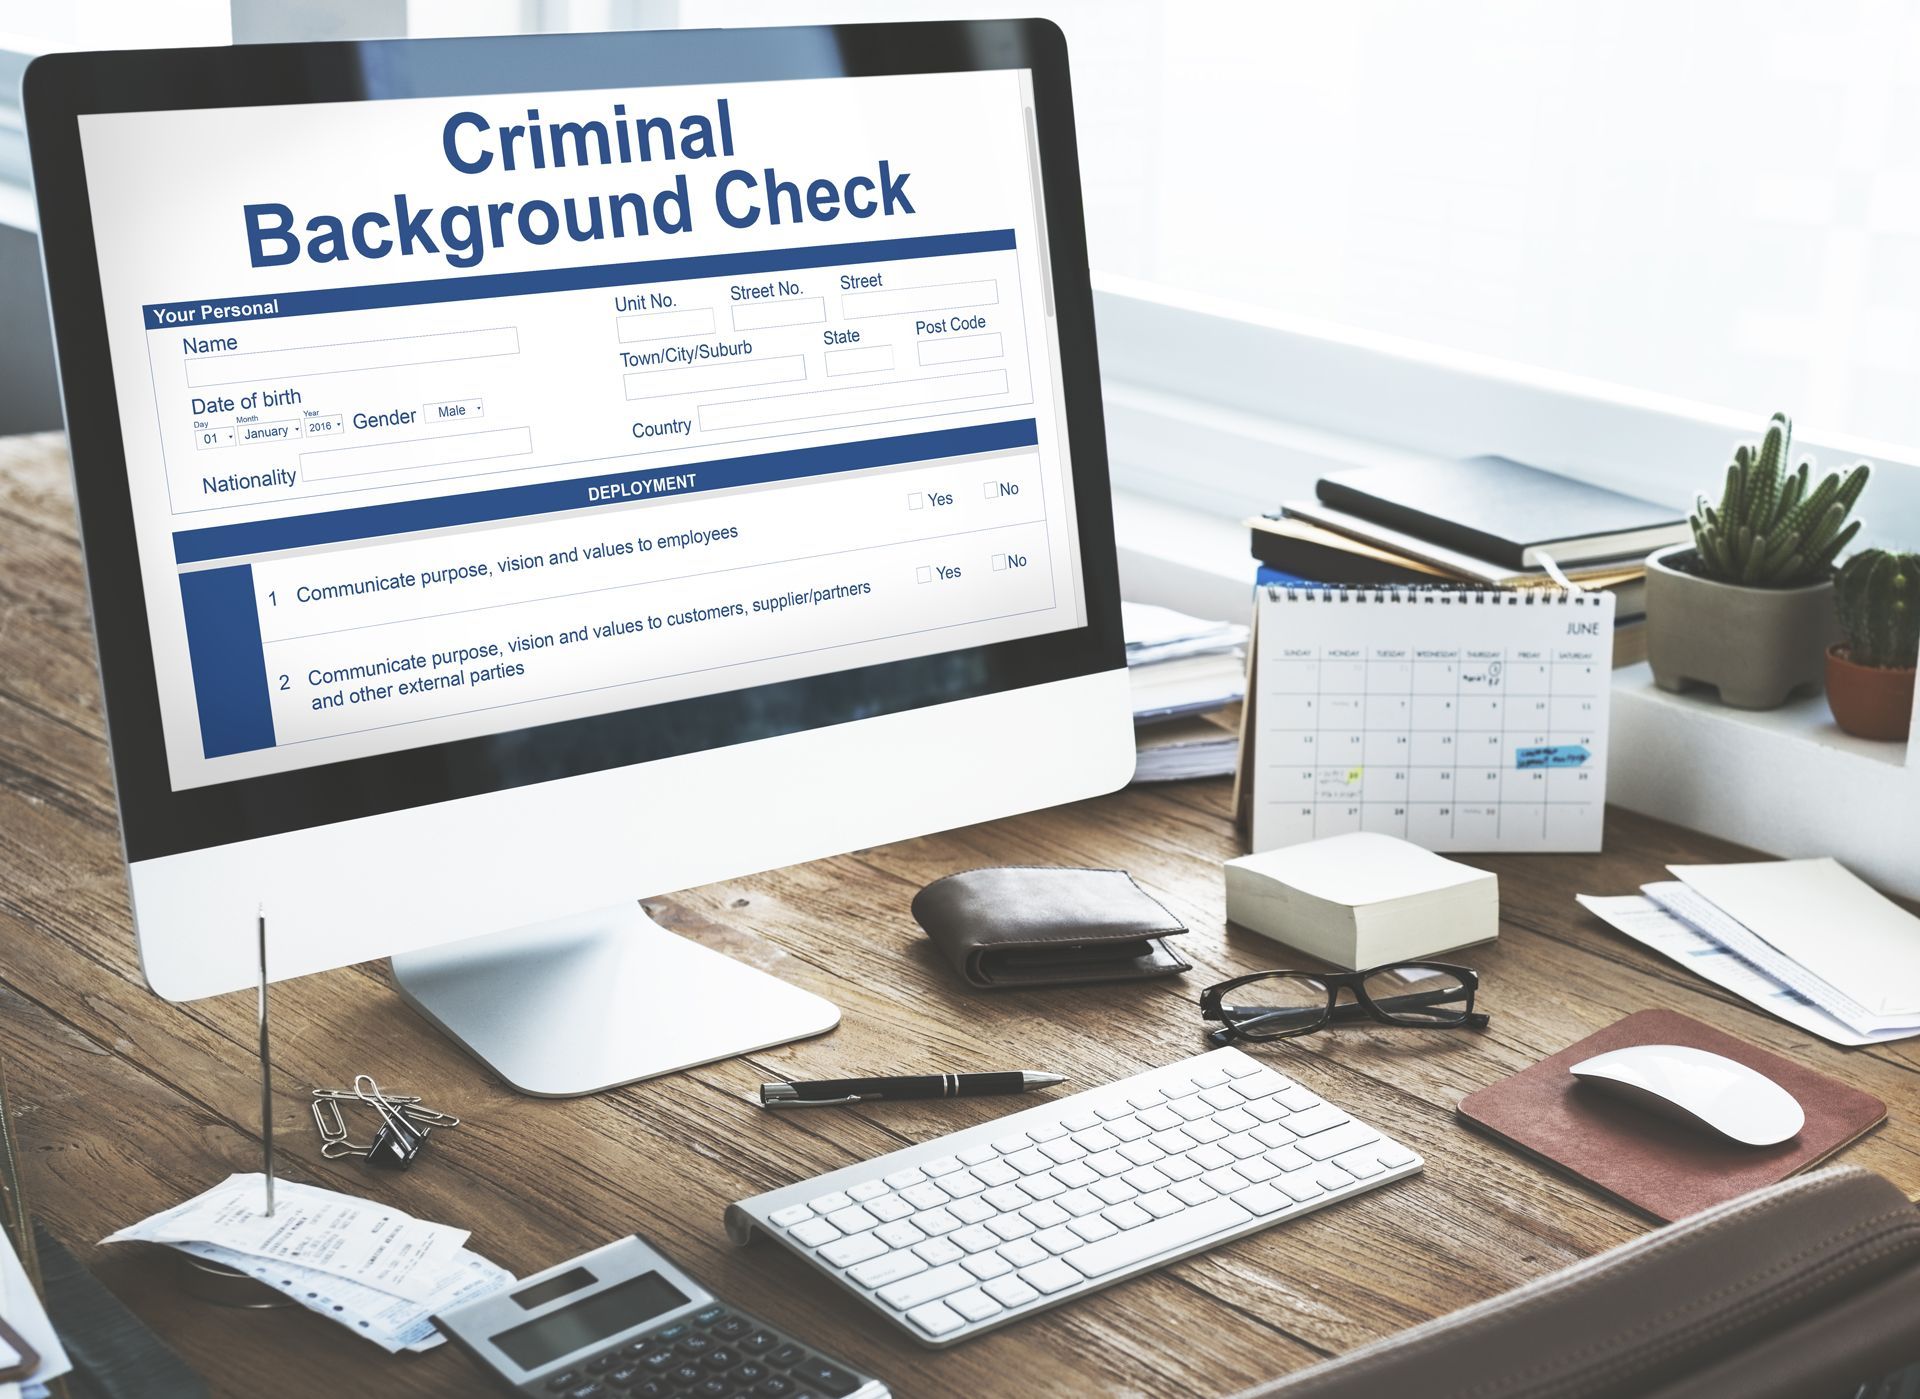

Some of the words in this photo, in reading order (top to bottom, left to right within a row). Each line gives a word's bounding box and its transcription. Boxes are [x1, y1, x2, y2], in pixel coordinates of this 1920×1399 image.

[442, 98, 735, 175] Criminal
[243, 173, 693, 269] Background
[715, 159, 917, 229] Check
[730, 282, 776, 301] Street
[778, 280, 804, 297] No.
[840, 272, 883, 290] Street
[152, 308, 196, 324] Your
[200, 298, 279, 320] Personal
[614, 294, 647, 313] Unit
[650, 292, 677, 309] No.
[915, 319, 948, 336] Post
[950, 314, 986, 332] Code
[182, 337, 238, 355] Name
[823, 328, 861, 346] State
[619, 339, 753, 368] Town/City/Suburb
[191, 396, 235, 416] Date
[240, 391, 258, 410] of
[262, 388, 302, 408] birth
[438, 404, 466, 418] Male
[236, 415, 259, 424] Month
[303, 409, 320, 418] Year
[352, 408, 417, 430] Gender
[193, 421, 209, 430] Day
[244, 425, 289, 440] January
[309, 421, 332, 433] 2016
[632, 418, 692, 439] Country
[203, 432, 217, 445] 01
[202, 468, 297, 495] Nationality
[587, 473, 697, 502] DEPLOYMENT
[927, 492, 954, 507] Yes
[999, 481, 1019, 497] No
[268, 590, 277, 607] 1
[296, 571, 416, 603] Communicate
[421, 563, 493, 586] purpose,
[497, 553, 544, 573] vision
[549, 546, 578, 566] and
[583, 540, 634, 561] values
[637, 537, 653, 553] to
[657, 525, 739, 551] employees
[936, 565, 962, 580] Yes
[1007, 553, 1027, 569] No
[278, 674, 291, 691] 2
[308, 653, 427, 686] Communicate
[431, 641, 504, 669] purpose,
[508, 633, 554, 654] vision
[559, 625, 589, 645] and
[593, 619, 643, 640] values
[648, 614, 662, 630] to
[667, 602, 749, 627] customers,
[752, 580, 871, 613] supplier/partners
[1566, 622, 1599, 636] JUNE
[1283, 649, 1312, 657] SUNDAY
[1328, 649, 1360, 658] MONDAY
[1376, 650, 1406, 658] TUESDAY
[1416, 650, 1457, 658] WEDNESDAY
[1517, 651, 1541, 659] FRIDAY
[1559, 652, 1593, 660] SATURDAY
[311, 690, 344, 711] and
[349, 683, 394, 705] other
[398, 669, 465, 696] external
[470, 661, 525, 685] parties
